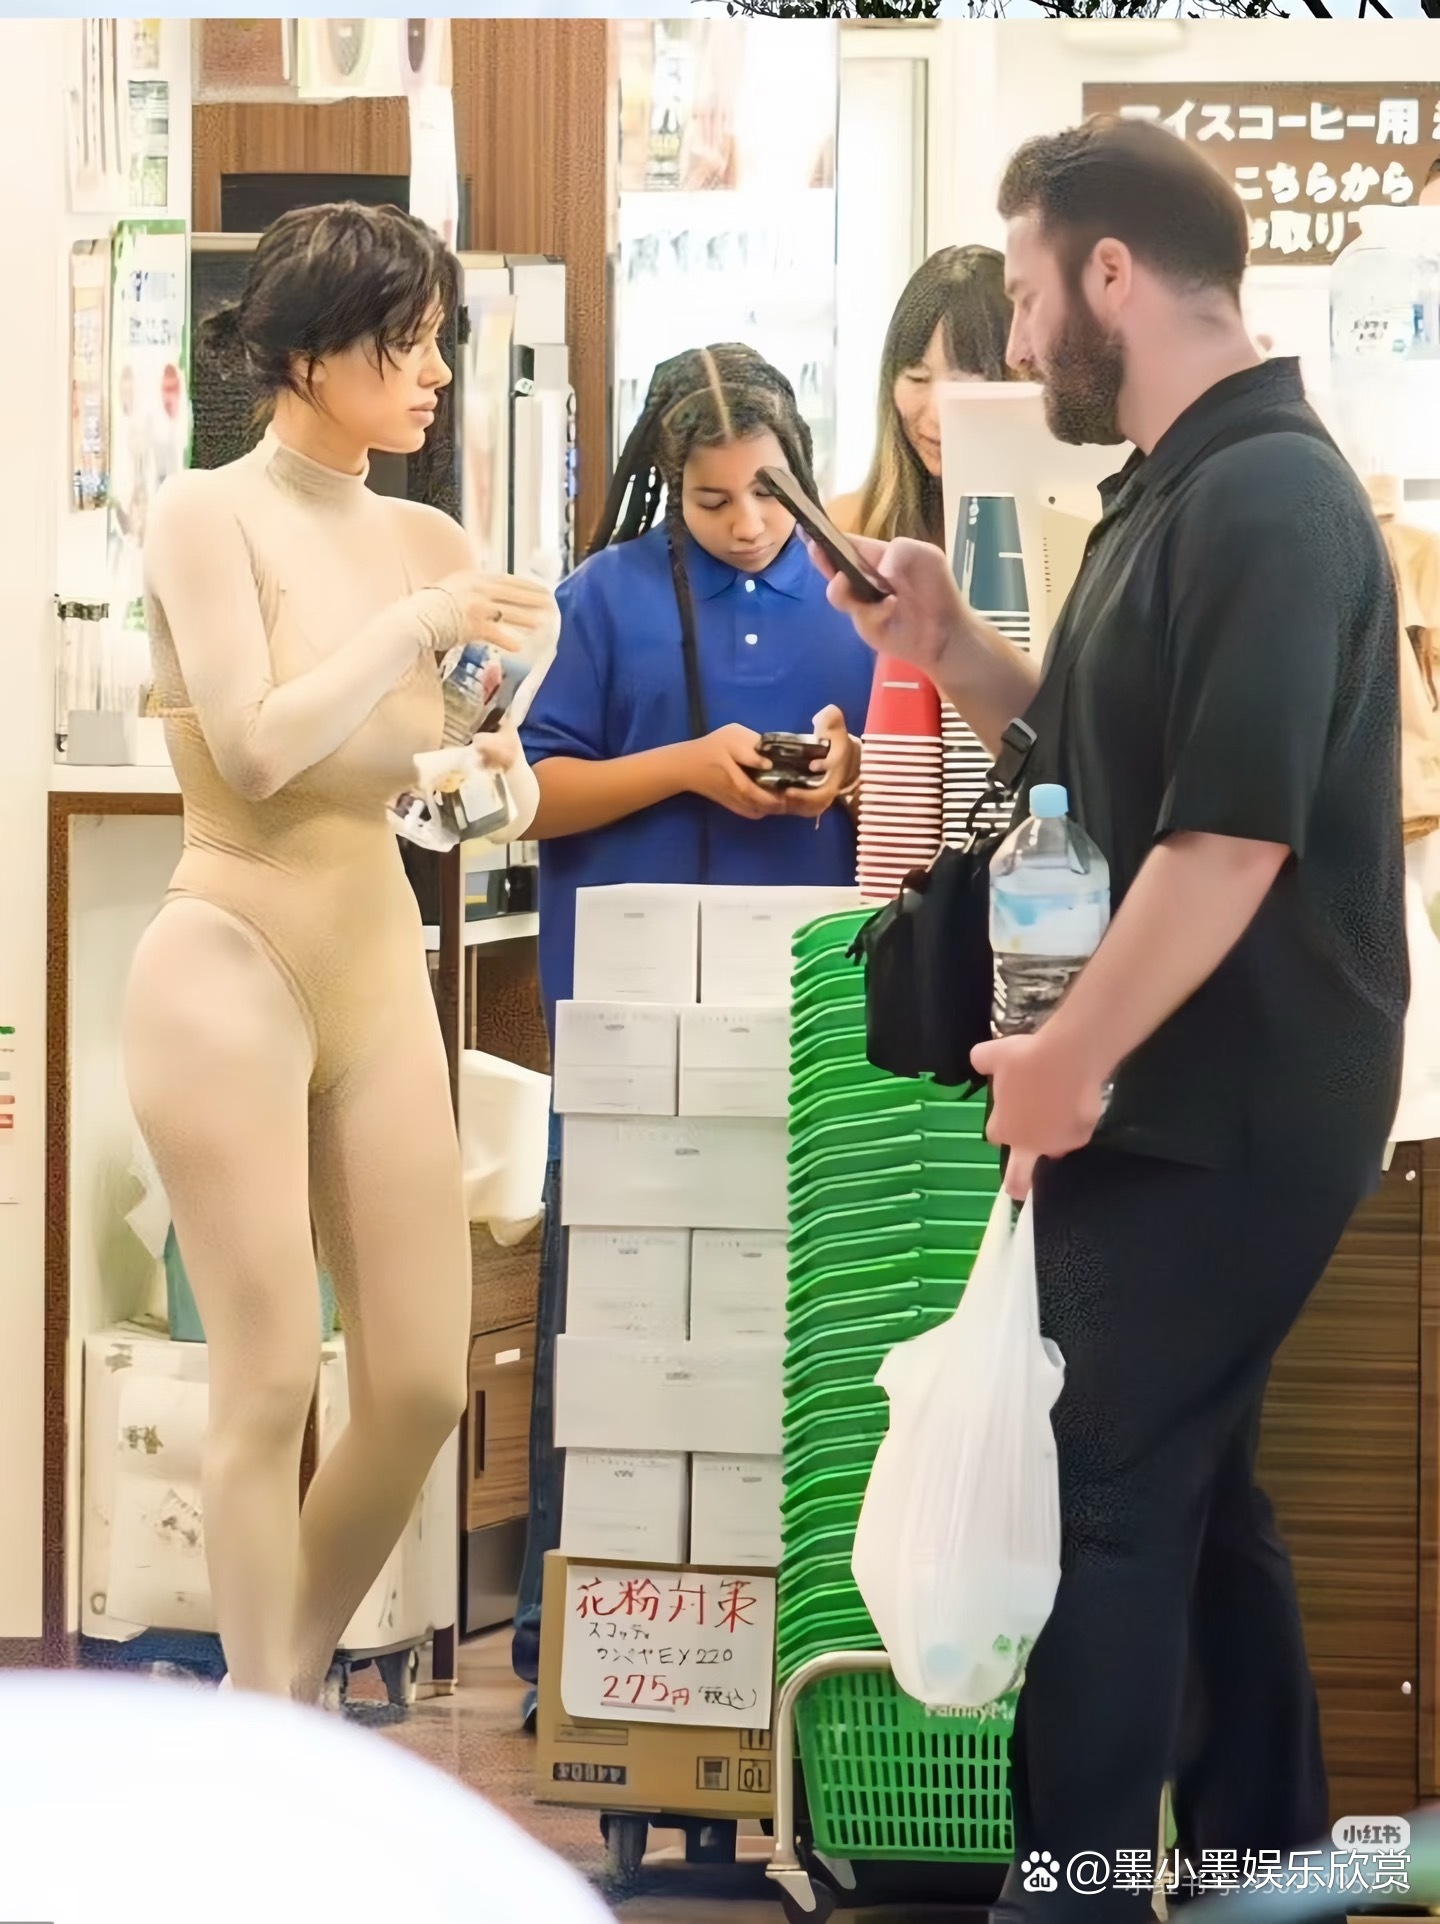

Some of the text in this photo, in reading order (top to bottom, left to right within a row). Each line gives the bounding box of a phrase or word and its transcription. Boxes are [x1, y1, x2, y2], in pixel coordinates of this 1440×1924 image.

[1119, 99, 1440, 145] イスコーヒー用
[1249, 210, 1362, 254] 取り
[575, 1576, 757, 1633] 花粉対策
